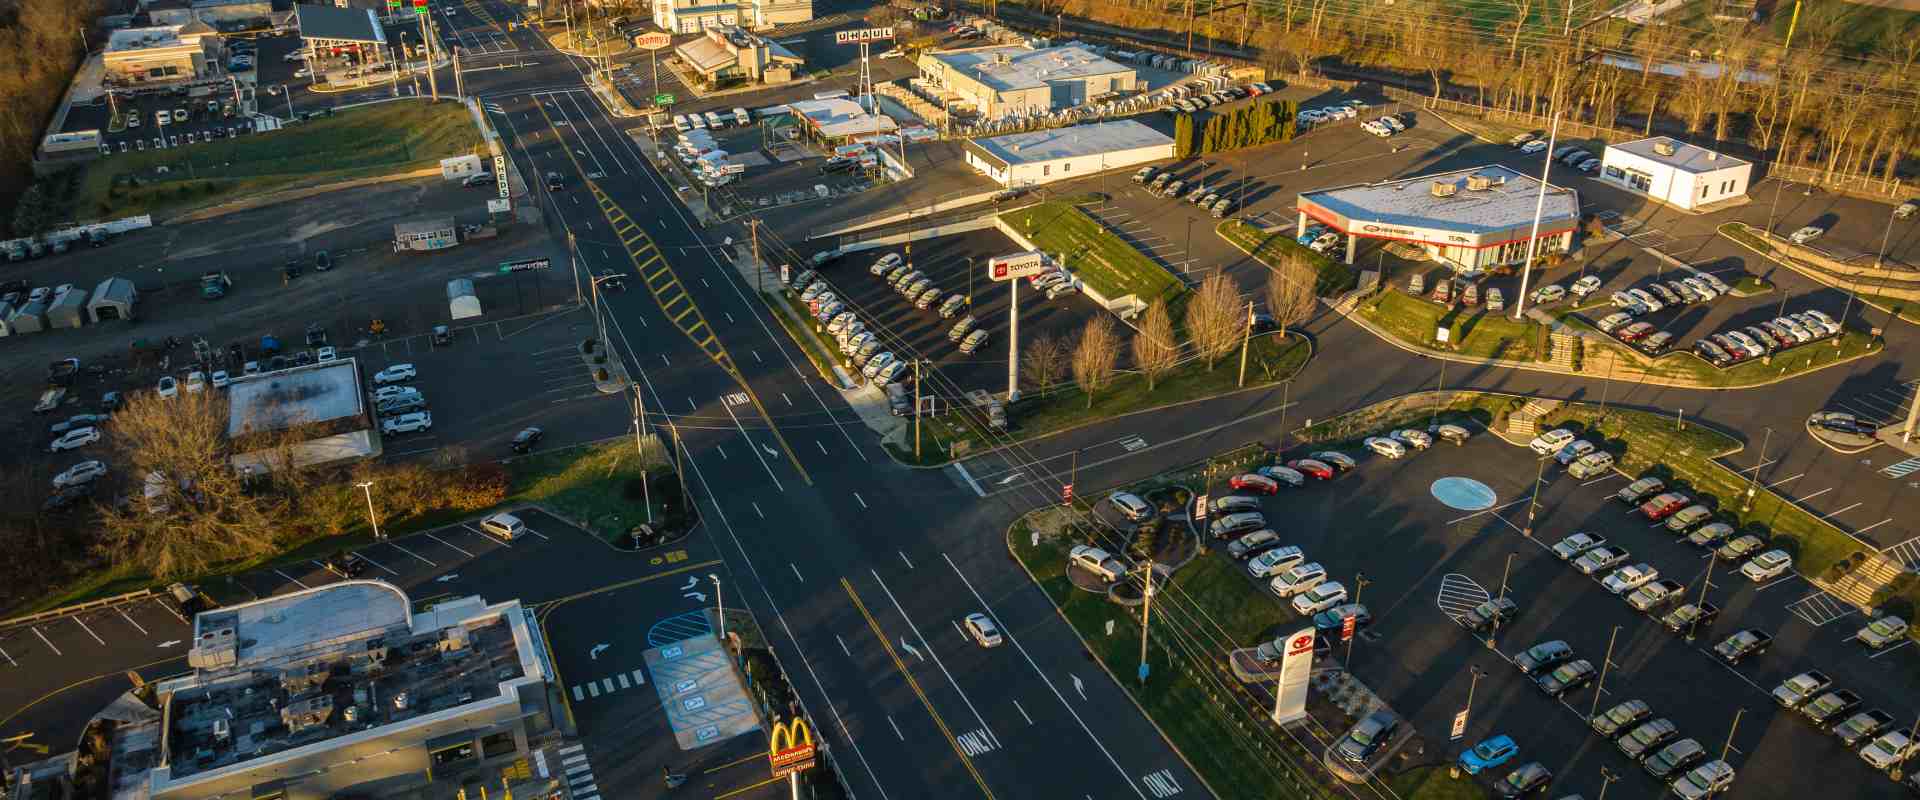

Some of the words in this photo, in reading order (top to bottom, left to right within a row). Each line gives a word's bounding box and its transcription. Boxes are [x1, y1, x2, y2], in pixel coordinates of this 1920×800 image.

[639, 36, 669, 46] Denny's
[496, 157, 508, 197] SHEDS
[1010, 261, 1038, 271] TOYOTA
[957, 728, 995, 756] ONLY
[1143, 769, 1183, 798] ONLY
